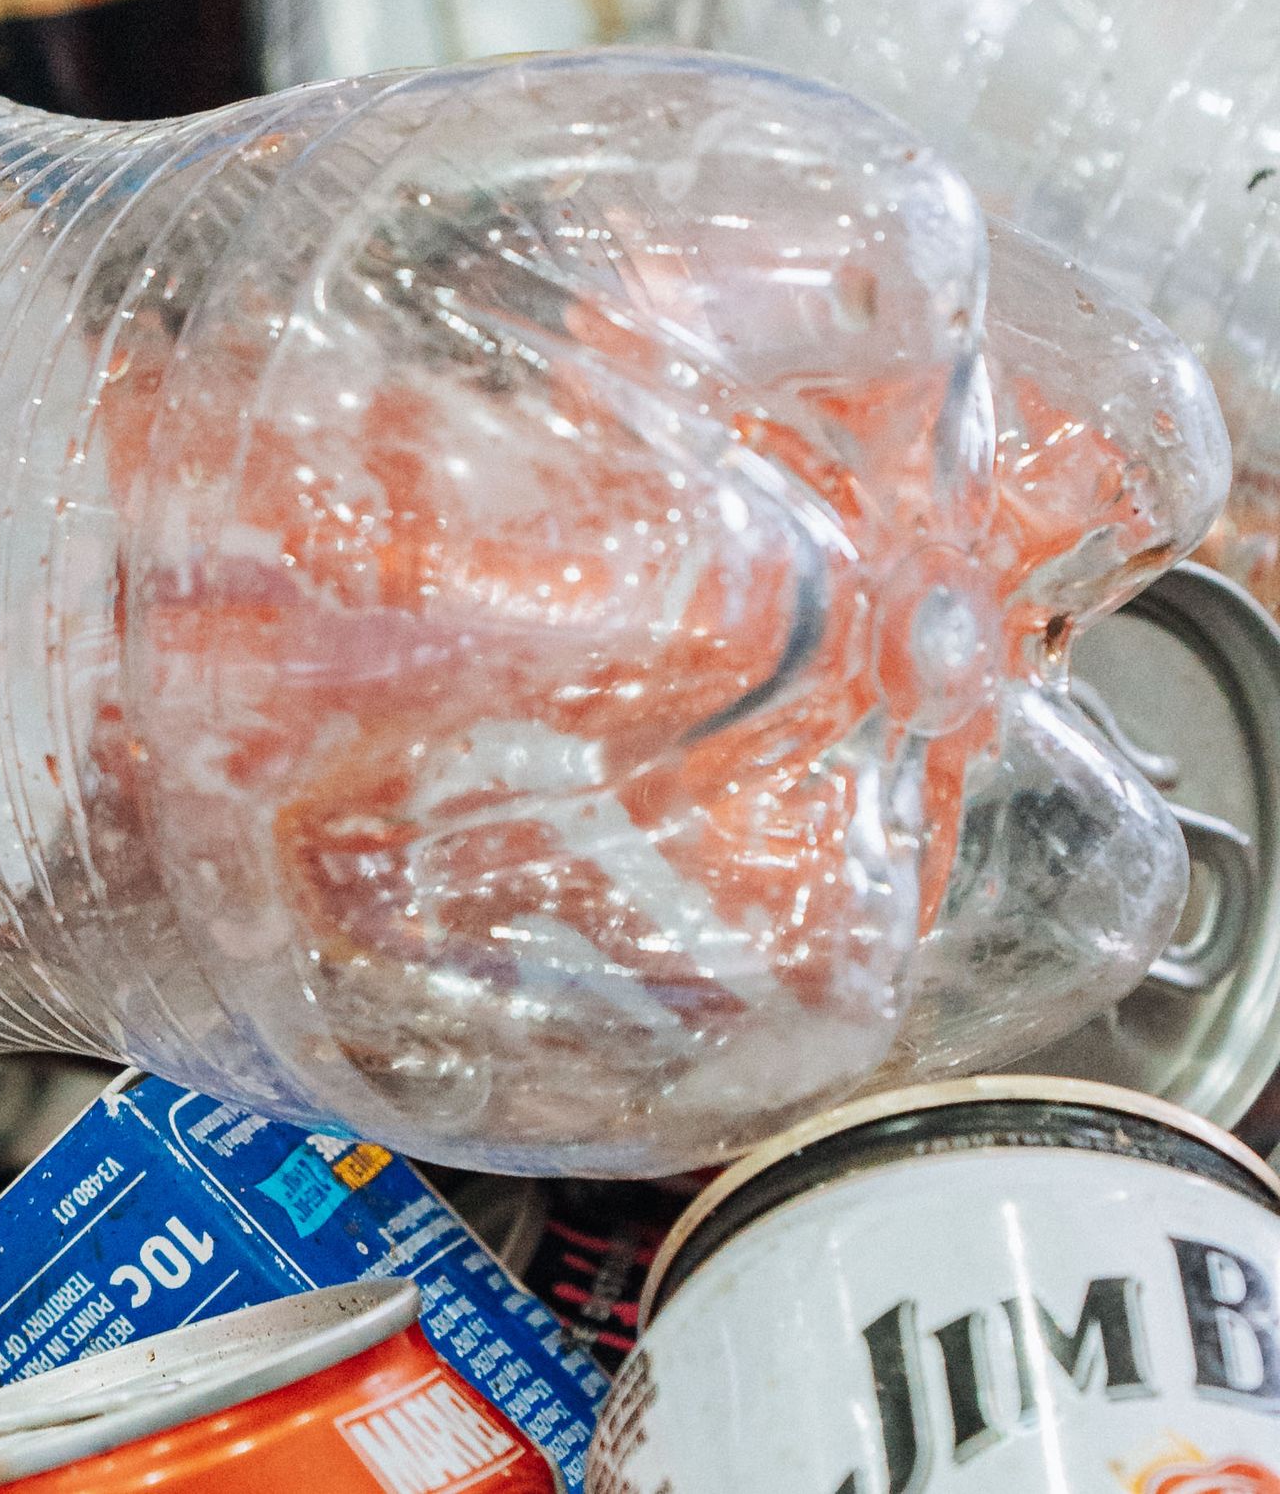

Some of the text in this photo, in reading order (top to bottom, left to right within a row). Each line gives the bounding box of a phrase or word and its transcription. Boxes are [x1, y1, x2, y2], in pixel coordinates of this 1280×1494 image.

[50, 1155, 123, 1226] V3480.01
[106, 1214, 212, 1311] 10c
[18, 1269, 95, 1343] TERRITORY
[59, 1291, 115, 1347] POINTS
[0, 1331, 29, 1361] OF
[43, 1334, 70, 1361] IN
[834, 1276, 1158, 1494] JIM
